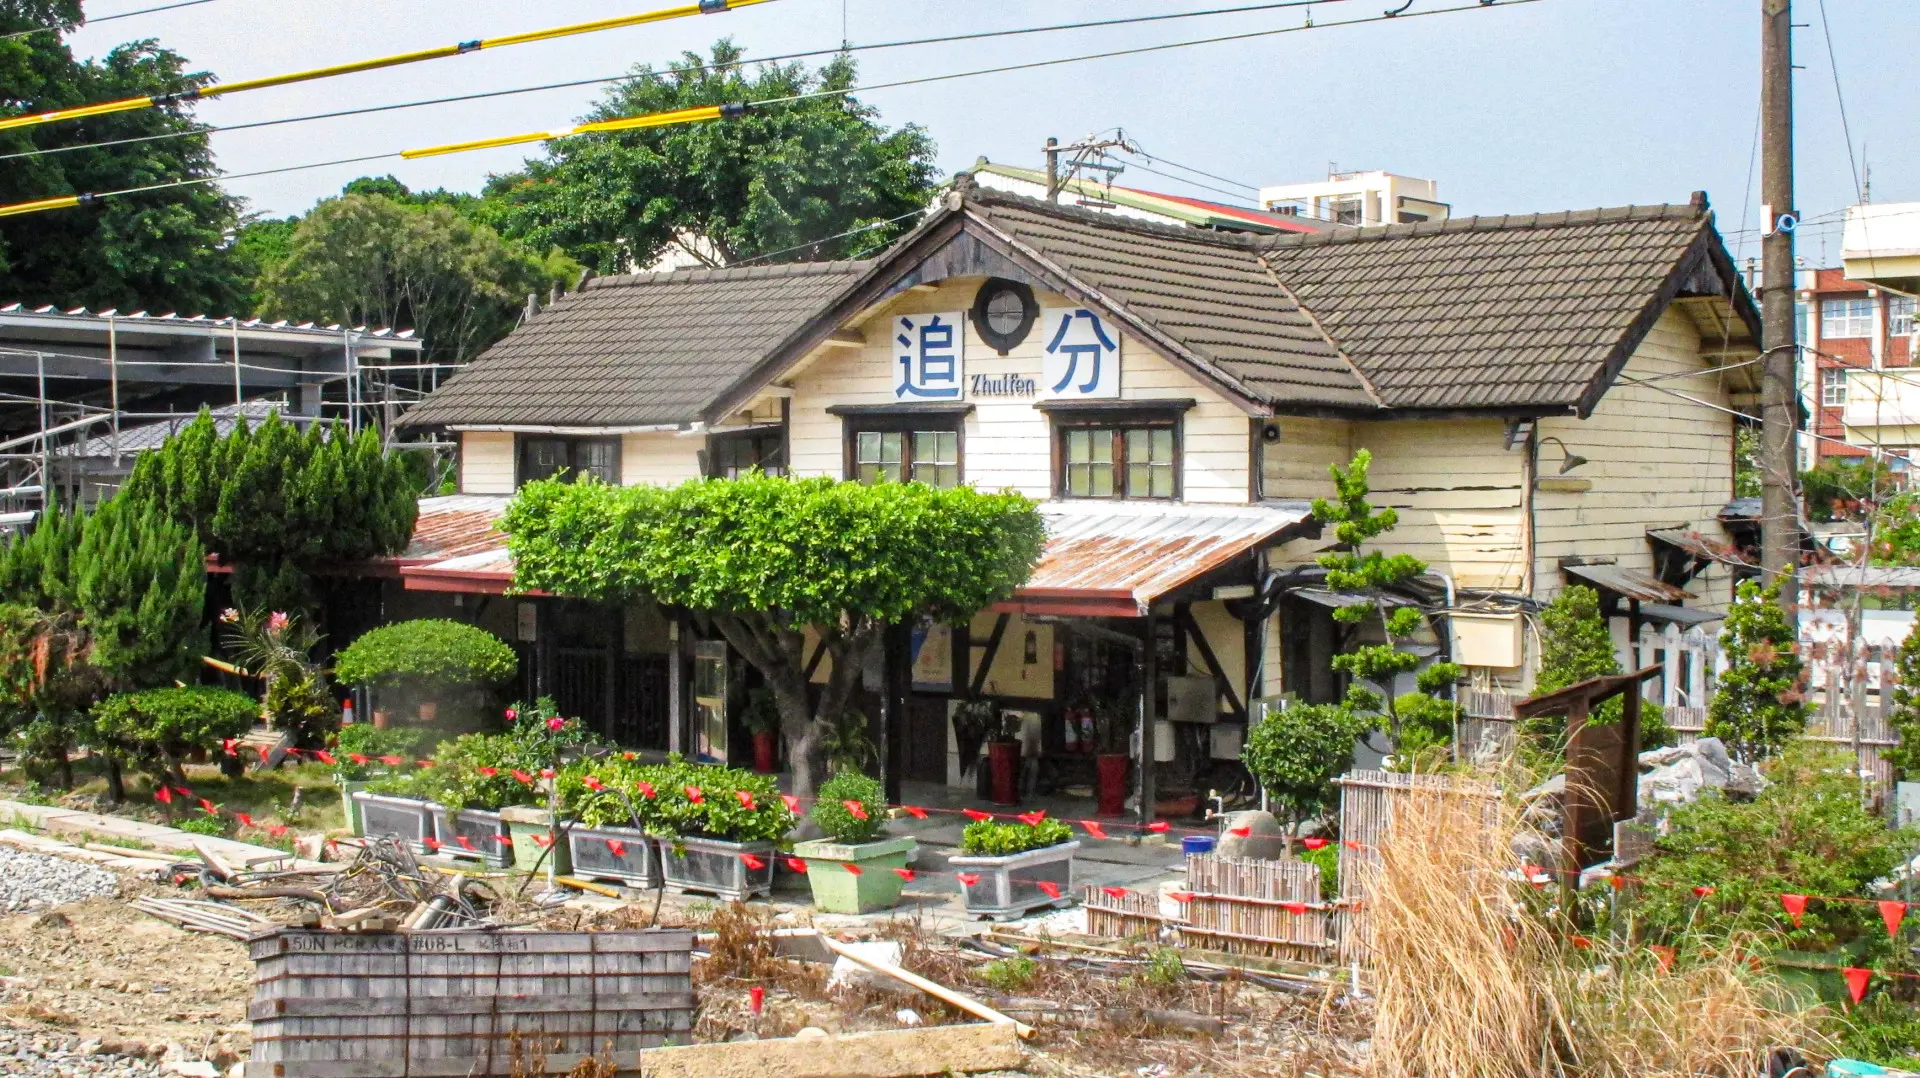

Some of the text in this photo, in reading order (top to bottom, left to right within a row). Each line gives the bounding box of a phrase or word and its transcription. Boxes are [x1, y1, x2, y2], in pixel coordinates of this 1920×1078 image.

[895, 309, 1117, 398] 追 分
[971, 373, 1036, 397] Zhuifen
